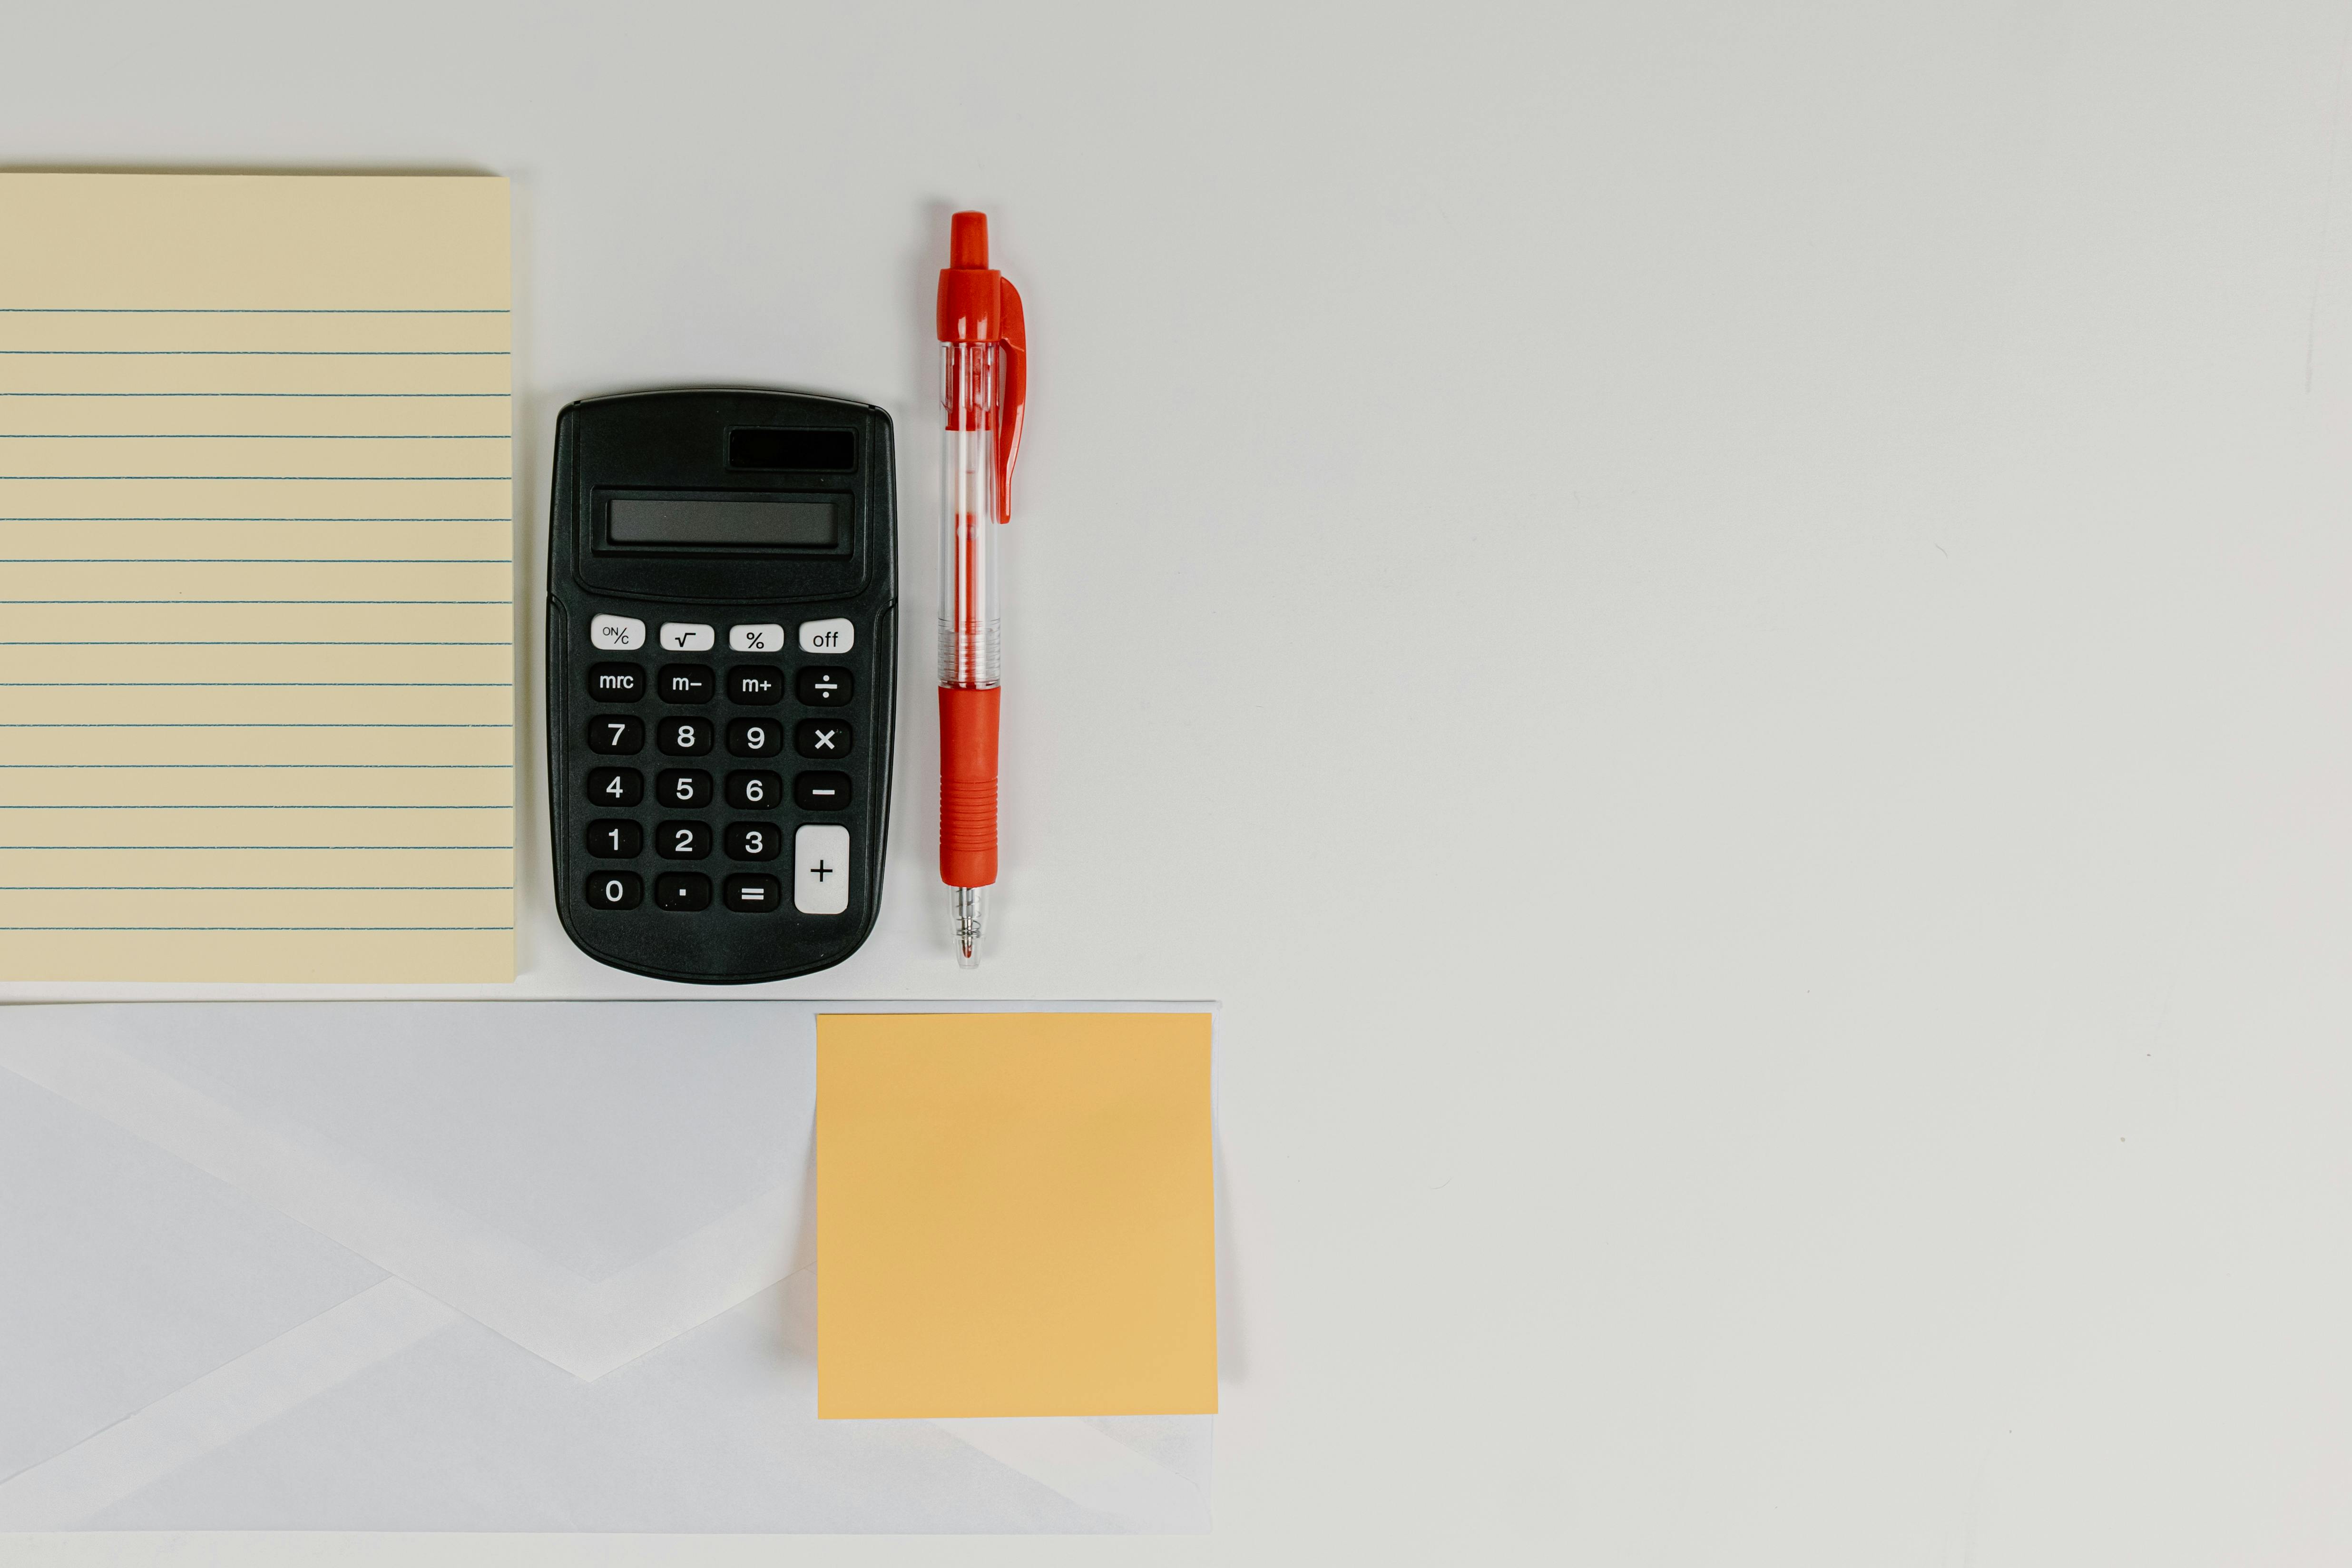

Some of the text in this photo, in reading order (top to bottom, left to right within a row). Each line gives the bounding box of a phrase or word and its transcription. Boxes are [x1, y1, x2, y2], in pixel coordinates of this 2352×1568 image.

[746, 632, 764, 649] %
[813, 631, 838, 647] off
[600, 676, 634, 689] mrc
[743, 679, 772, 692] m+
[815, 675, 838, 698] ÷
[608, 724, 625, 745] 7
[677, 725, 696, 747] 8
[747, 727, 765, 749] 9
[606, 776, 623, 798] 4
[676, 778, 694, 800] 5
[746, 780, 763, 802] 6
[608, 828, 618, 851] 1
[675, 829, 693, 852] 2
[745, 831, 763, 853] 3
[810, 860, 833, 882] +
[606, 880, 623, 902] 0
[741, 888, 764, 900] =
